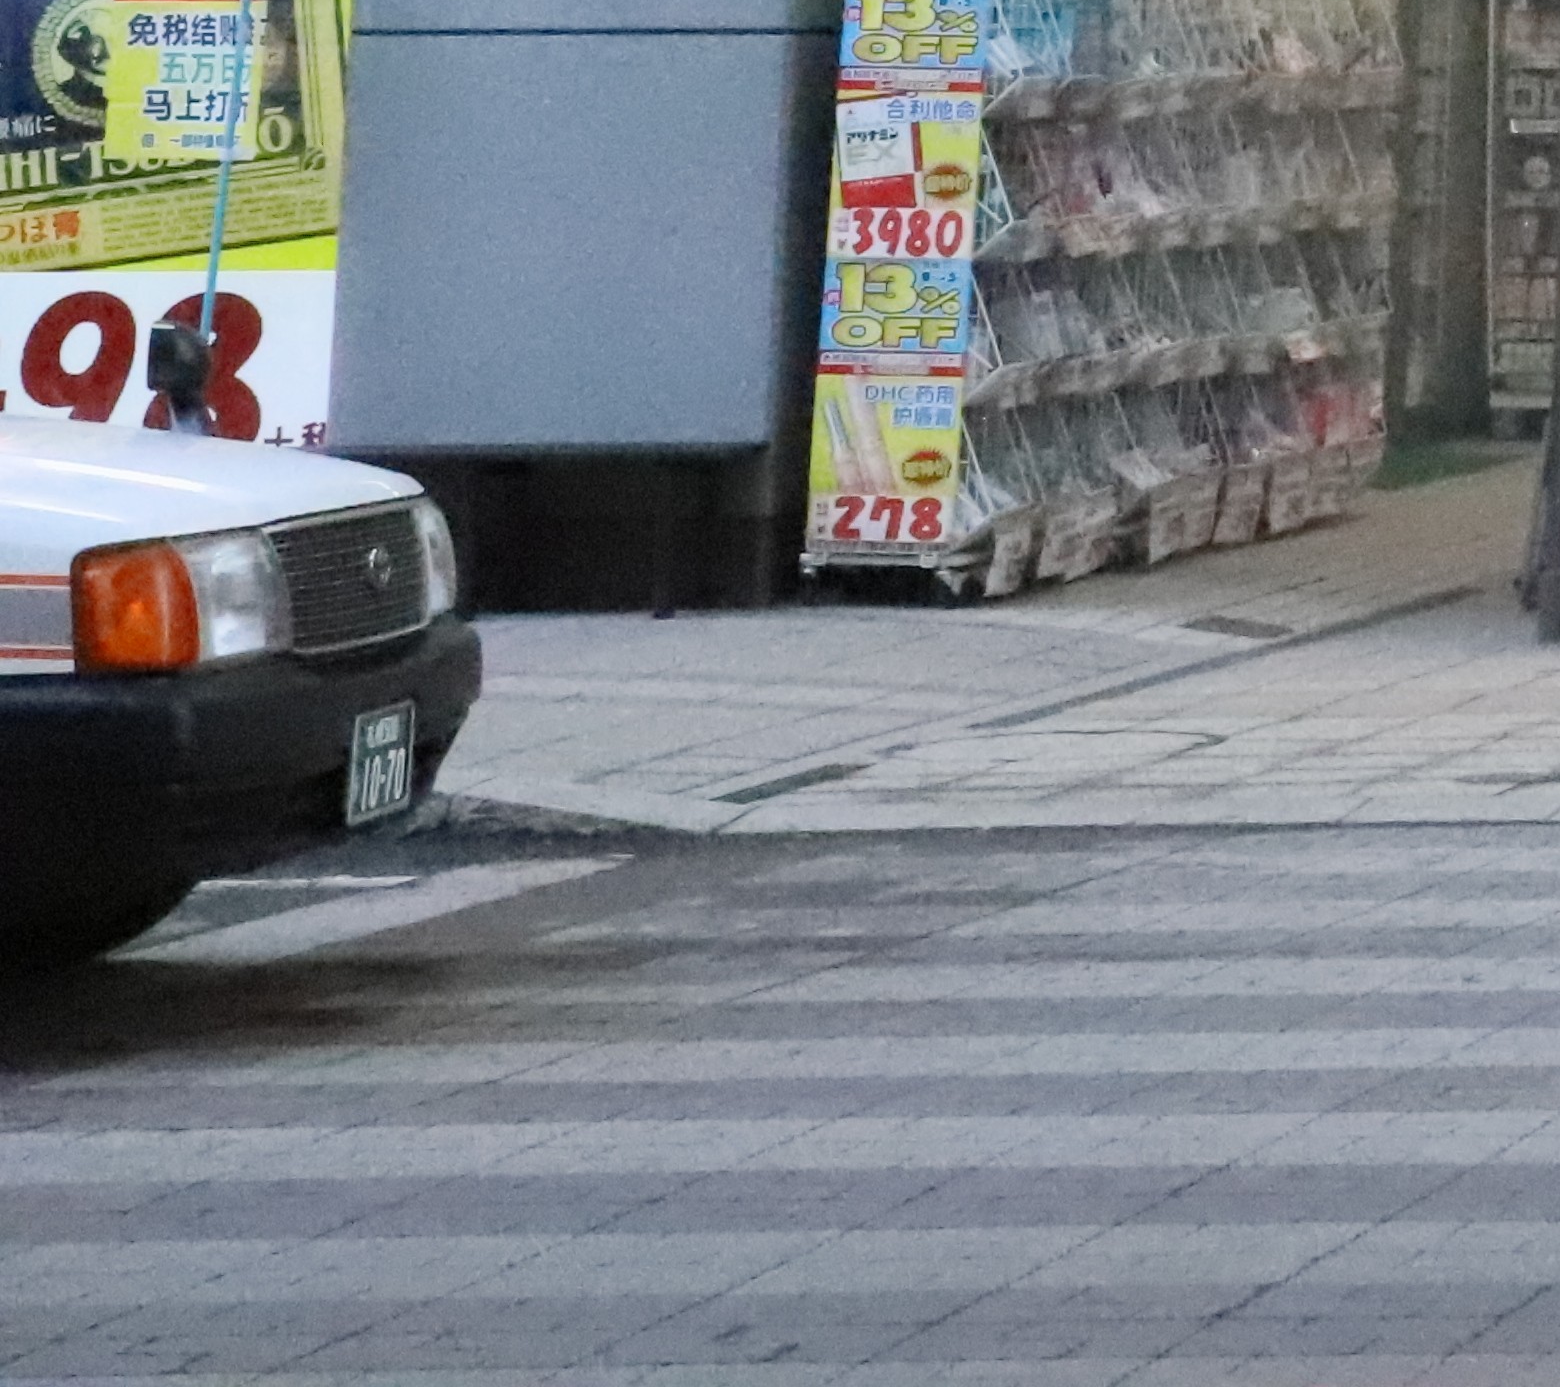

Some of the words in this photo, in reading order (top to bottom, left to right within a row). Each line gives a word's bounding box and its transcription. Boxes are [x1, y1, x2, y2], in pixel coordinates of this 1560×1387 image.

[852, 33, 979, 64] OFF
[886, 100, 977, 122] 合利他命
[852, 208, 963, 258] 3980
[836, 262, 961, 315] 13%
[831, 315, 960, 349] OFF
[832, 495, 943, 541] 278
